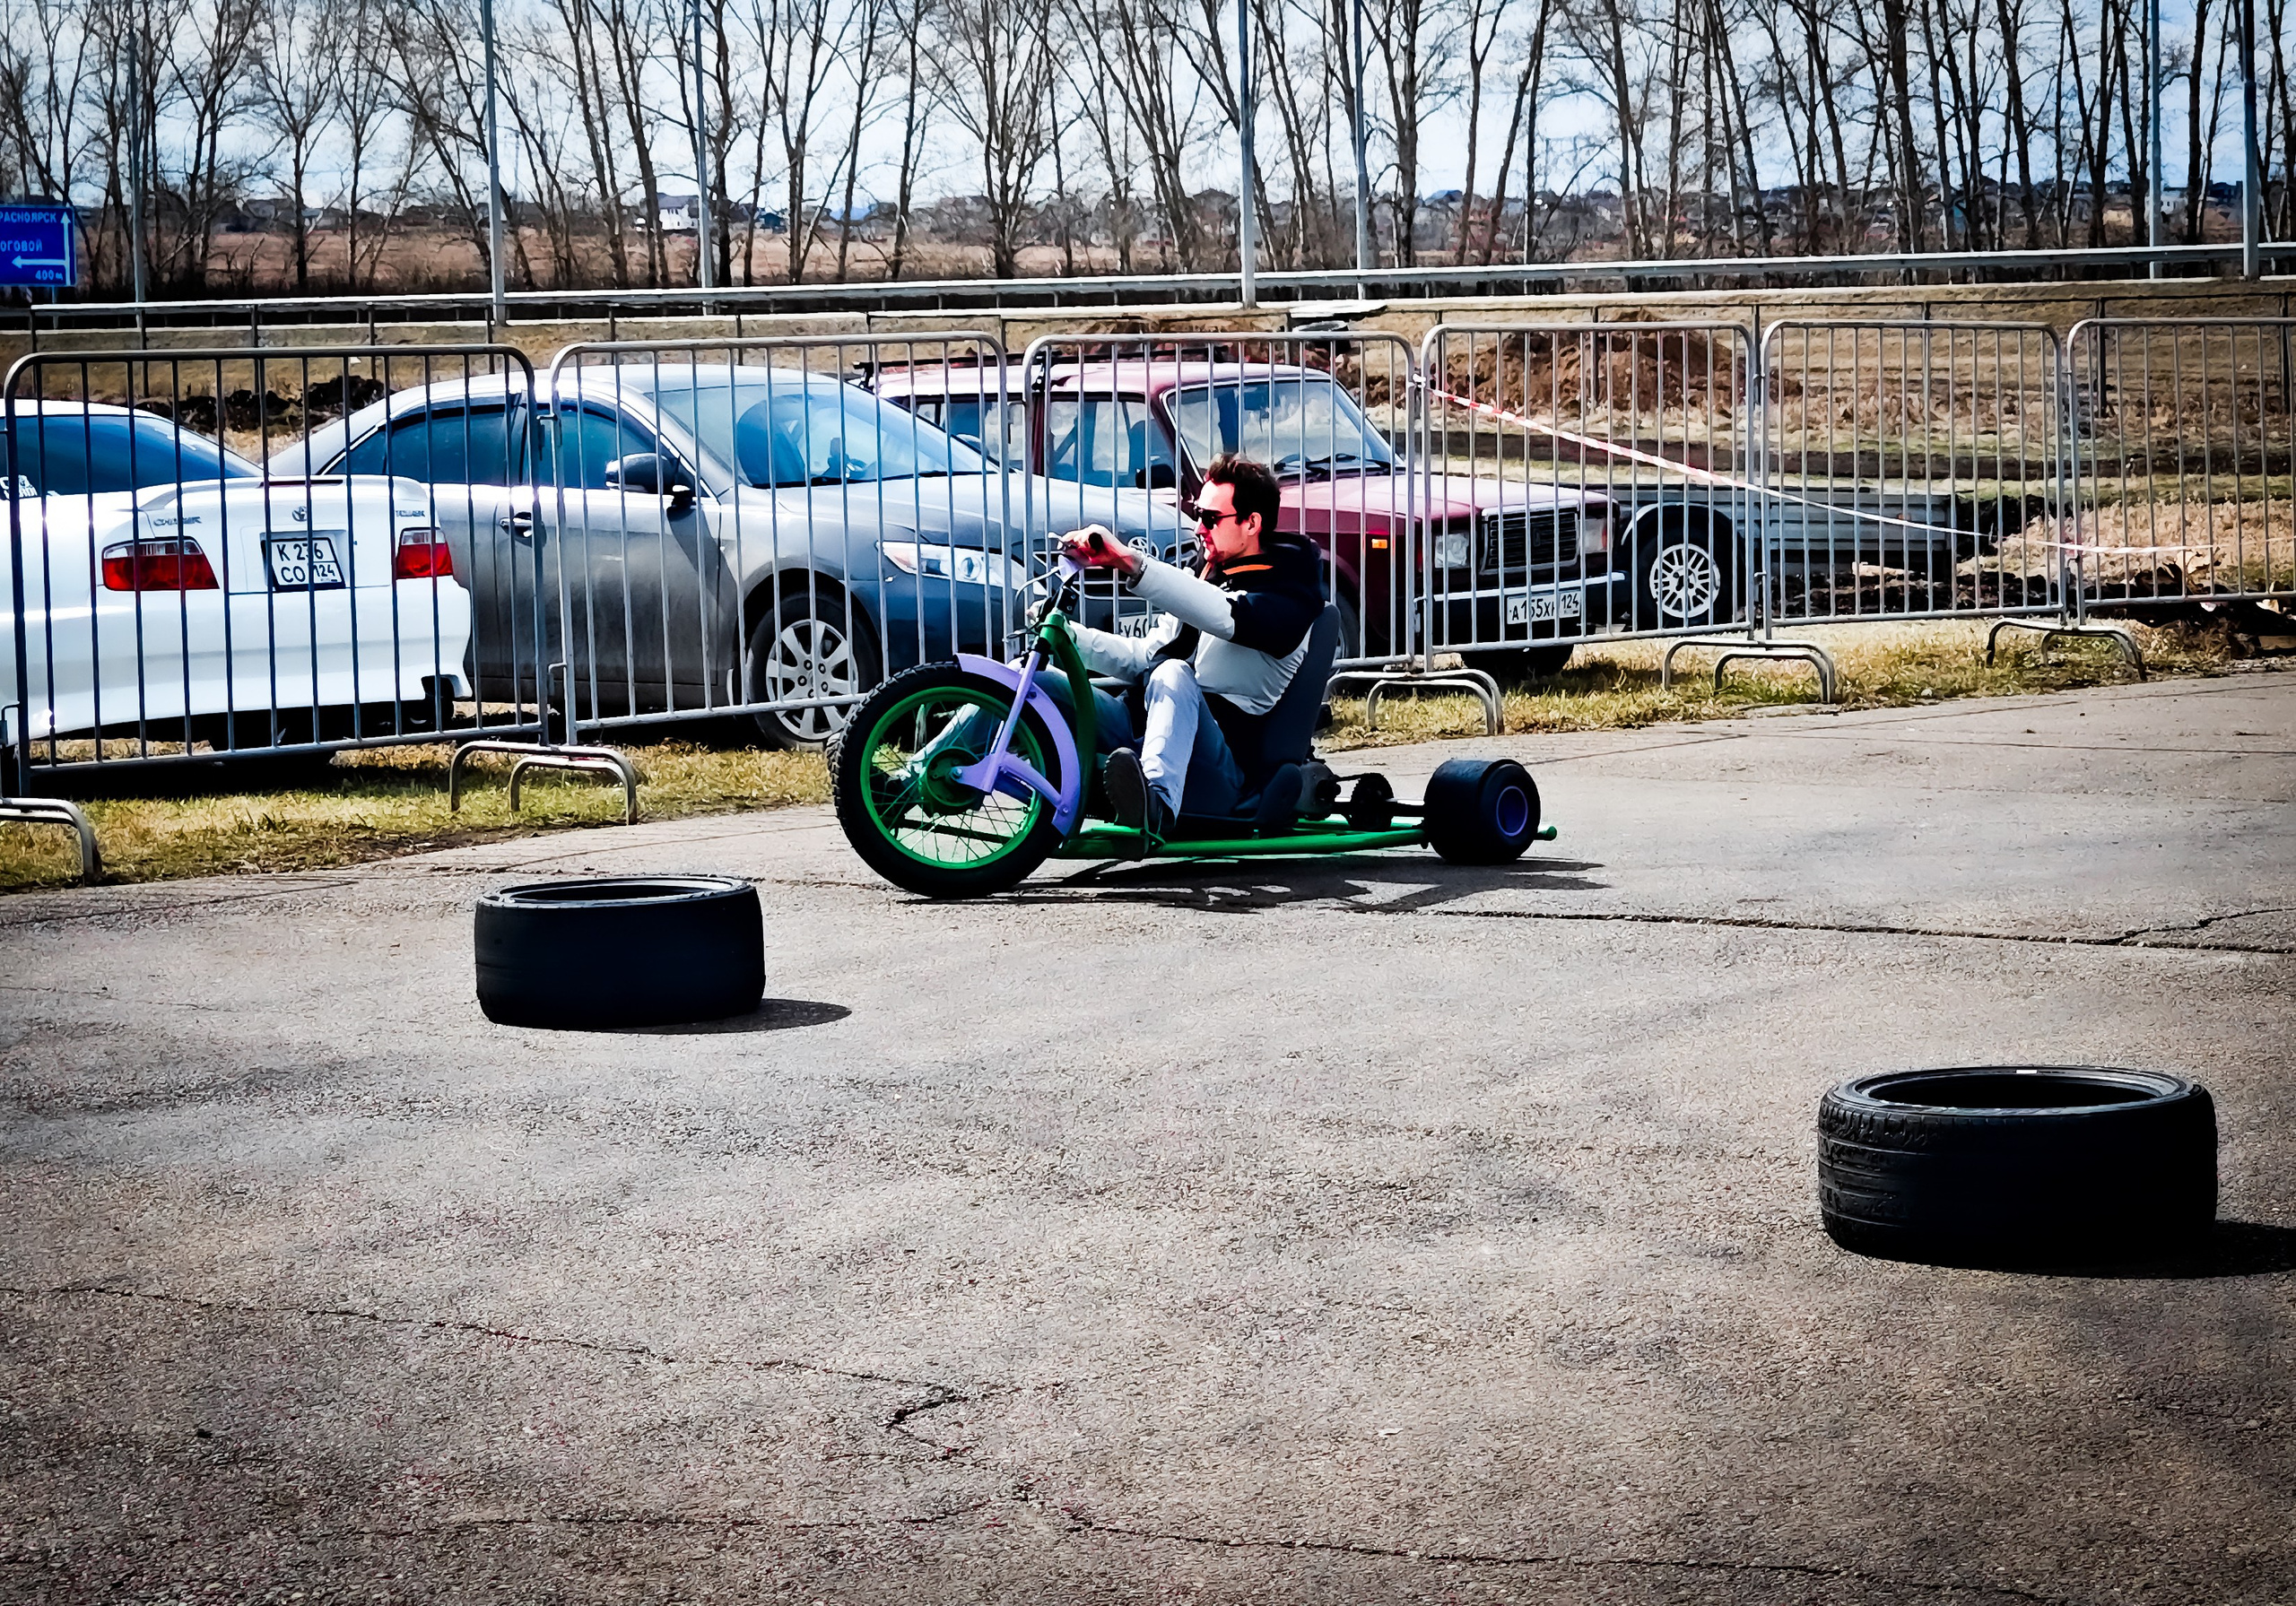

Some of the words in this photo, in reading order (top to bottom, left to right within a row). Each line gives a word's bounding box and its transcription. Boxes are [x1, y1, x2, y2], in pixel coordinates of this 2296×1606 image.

[35, 269, 55, 281] 400
[312, 564, 336, 577] 124
[1561, 592, 1579, 609] 124
